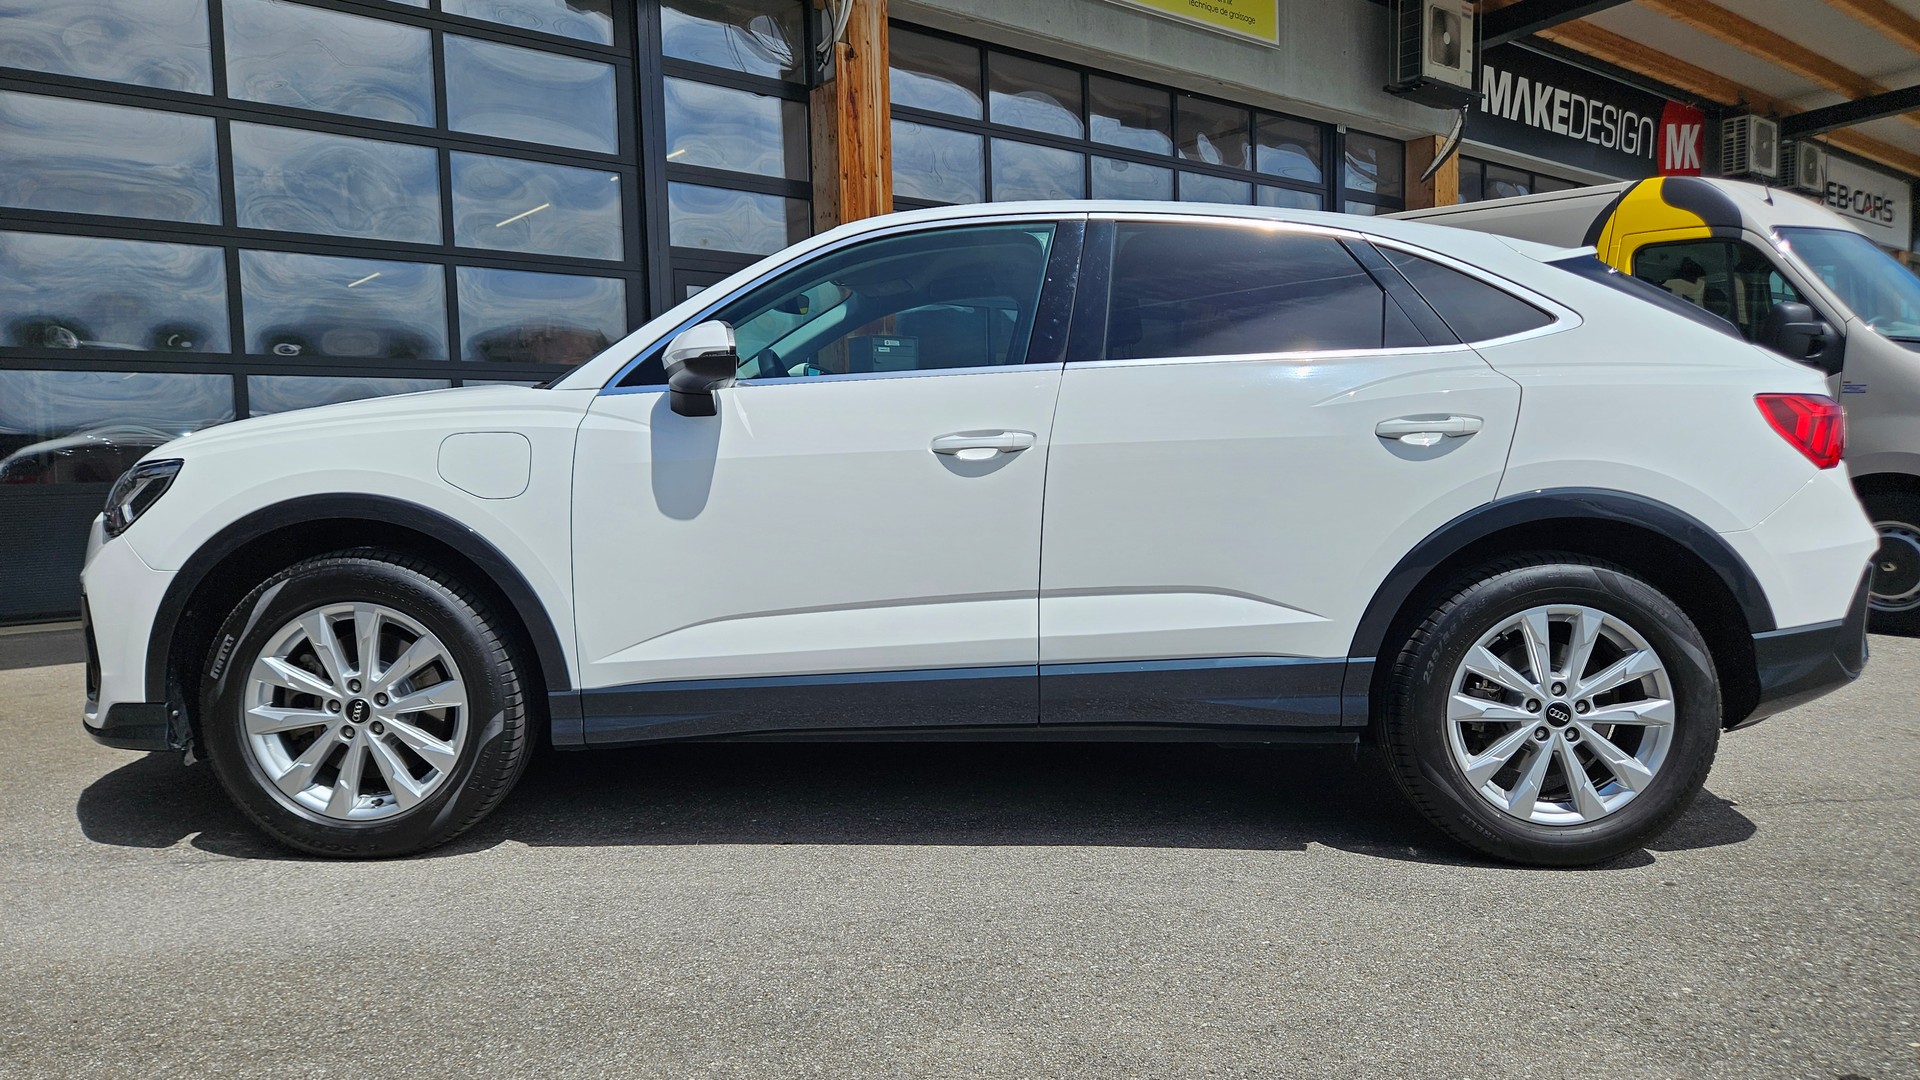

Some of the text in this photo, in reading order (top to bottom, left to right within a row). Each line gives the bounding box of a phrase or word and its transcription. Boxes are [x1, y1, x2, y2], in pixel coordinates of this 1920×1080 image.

[1220, 7, 1228, 16] de
[1229, 11, 1256, 25] graissage
[1665, 123, 1701, 170] MK
[1824, 181, 1894, 223] EB-CARS
